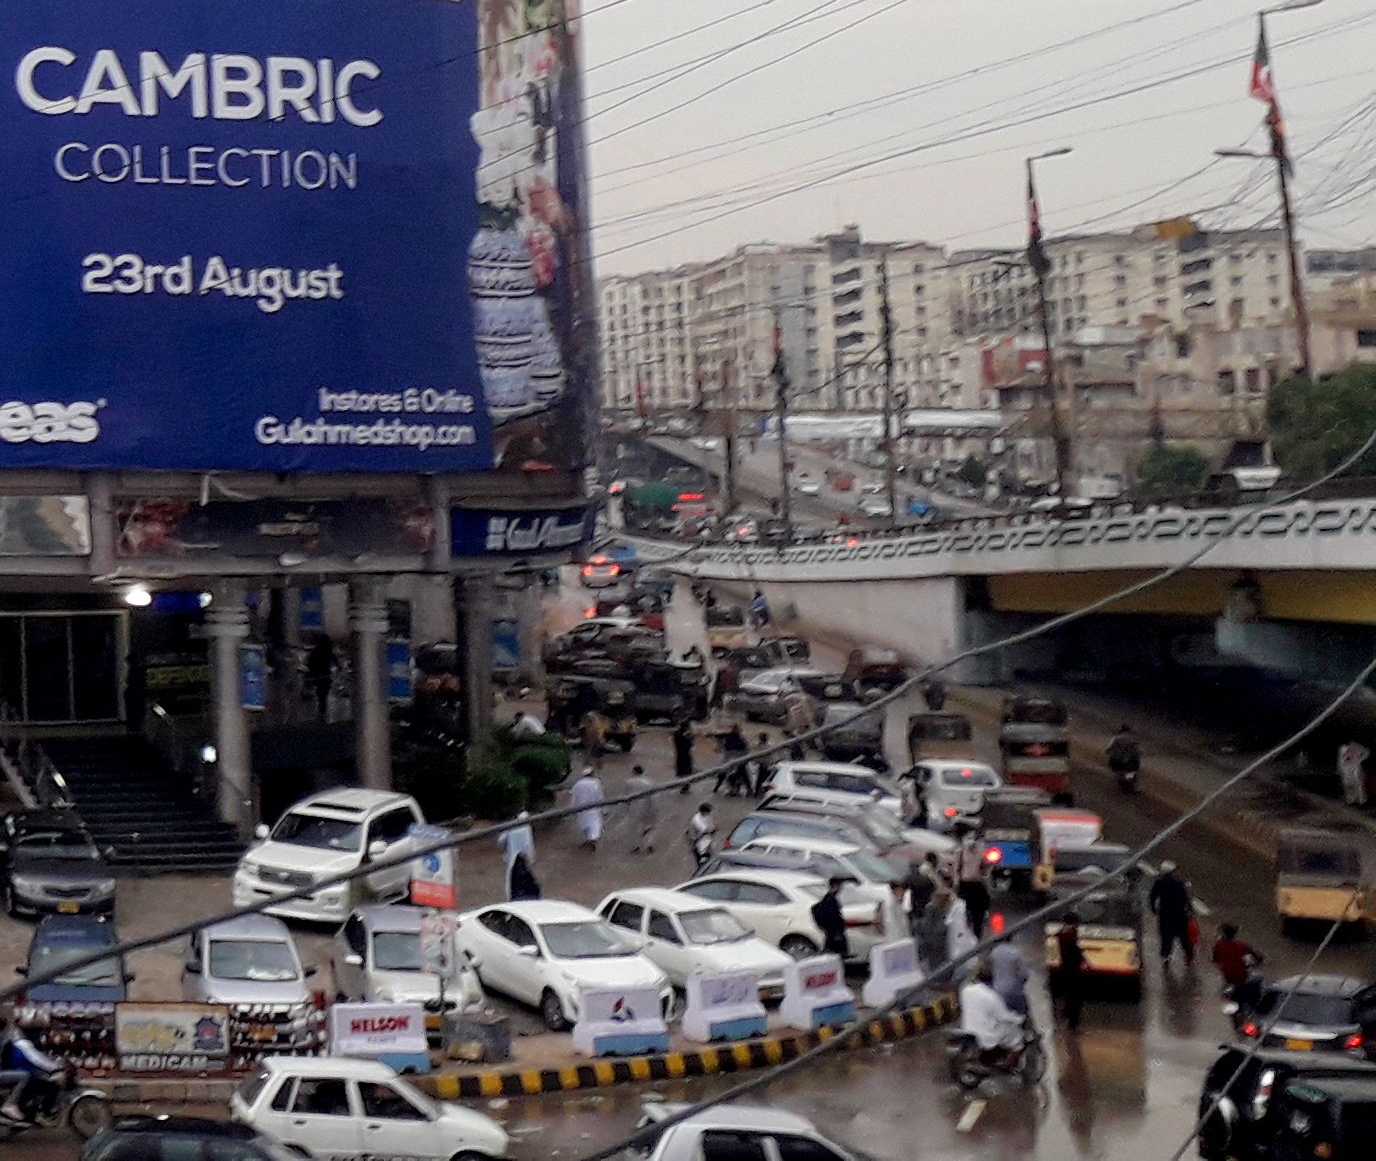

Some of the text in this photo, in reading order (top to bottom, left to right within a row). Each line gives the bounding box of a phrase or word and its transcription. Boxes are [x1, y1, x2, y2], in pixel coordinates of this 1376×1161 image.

[15, 46, 385, 127] CAMBRIC
[54, 141, 358, 190] COLLECTION
[81, 252, 345, 313] 23rd August
[319, 387, 402, 413] Instores
[421, 387, 475, 413] Online
[254, 415, 477, 451] Gulahmedshop.com
[120, 1053, 209, 1072] MEDICAM
